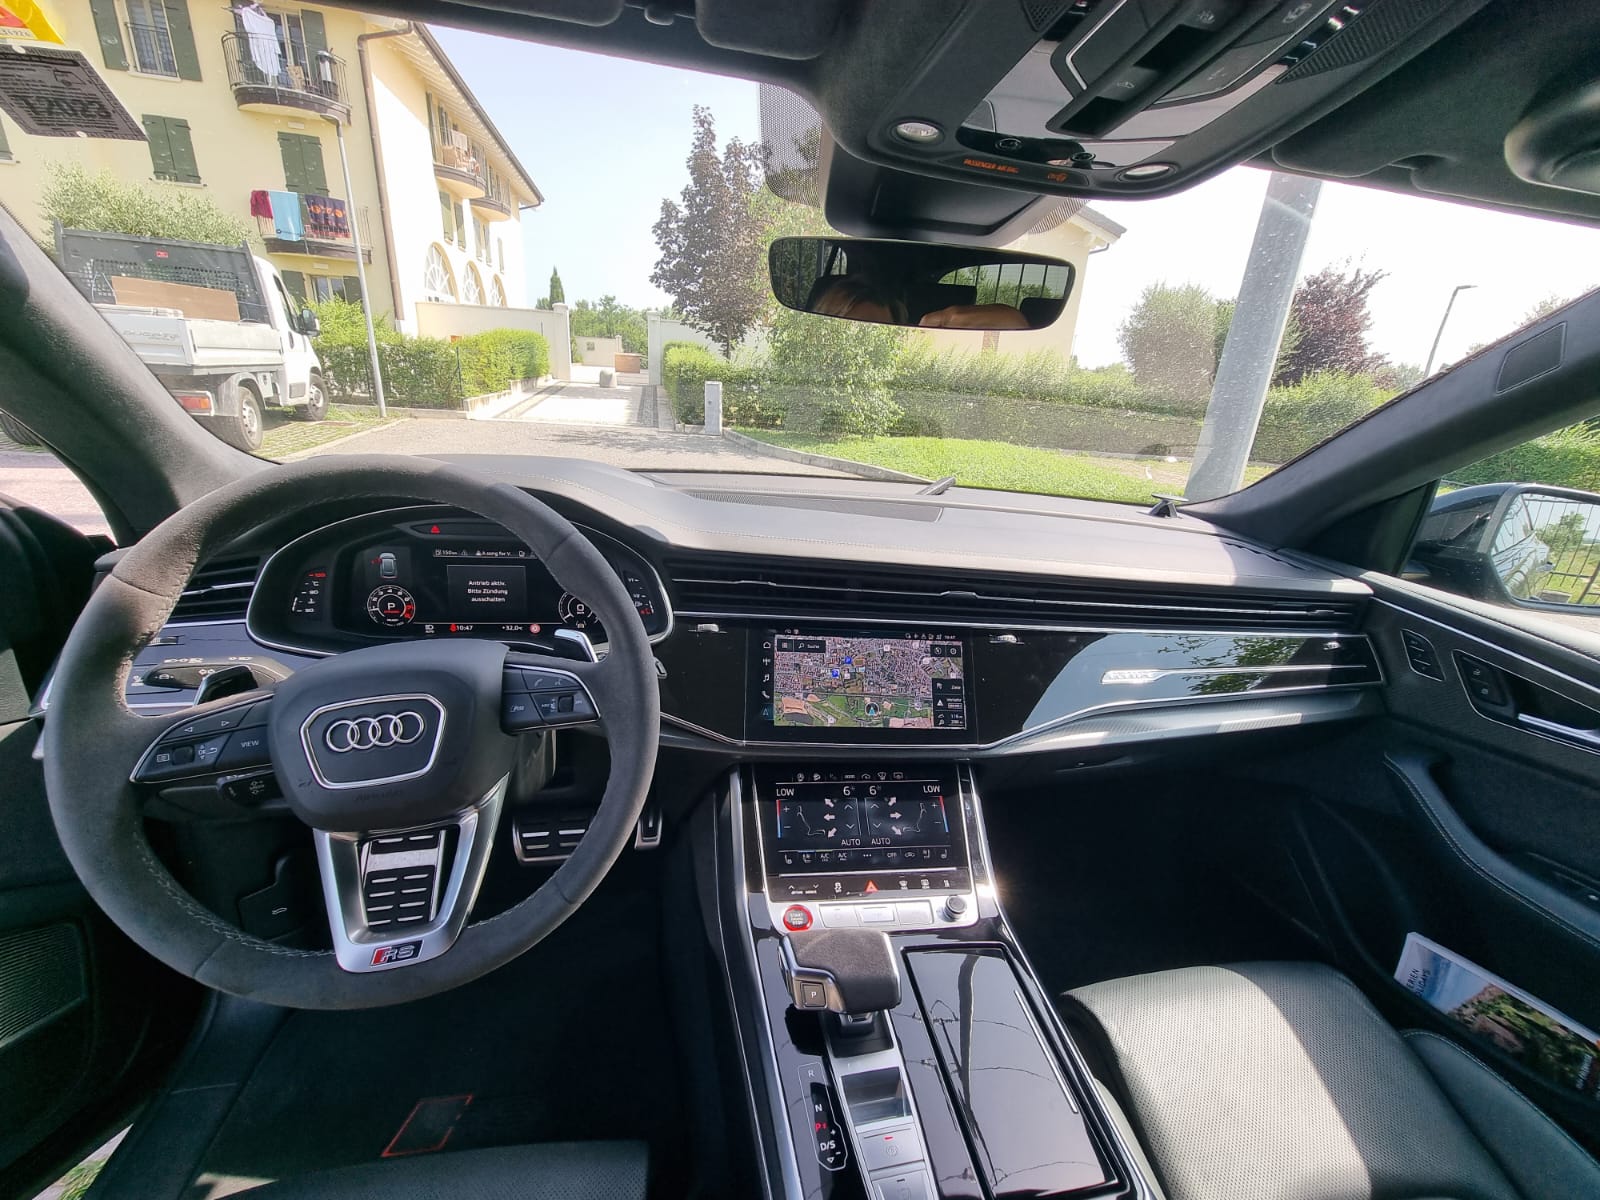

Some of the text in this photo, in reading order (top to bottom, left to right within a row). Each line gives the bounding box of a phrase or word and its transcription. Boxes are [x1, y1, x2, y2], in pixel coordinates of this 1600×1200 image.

[387, 602, 396, 610] P
[240, 739, 260, 748] VIEW
[776, 785, 941, 797] LOW 6 6 LOW
[841, 837, 891, 846] AUTO AUTO
[376, 943, 417, 964] RS
[811, 991, 817, 999] P
[808, 1069, 815, 1077] R
[815, 1103, 823, 1112] N
[820, 1140, 836, 1151] D/S
